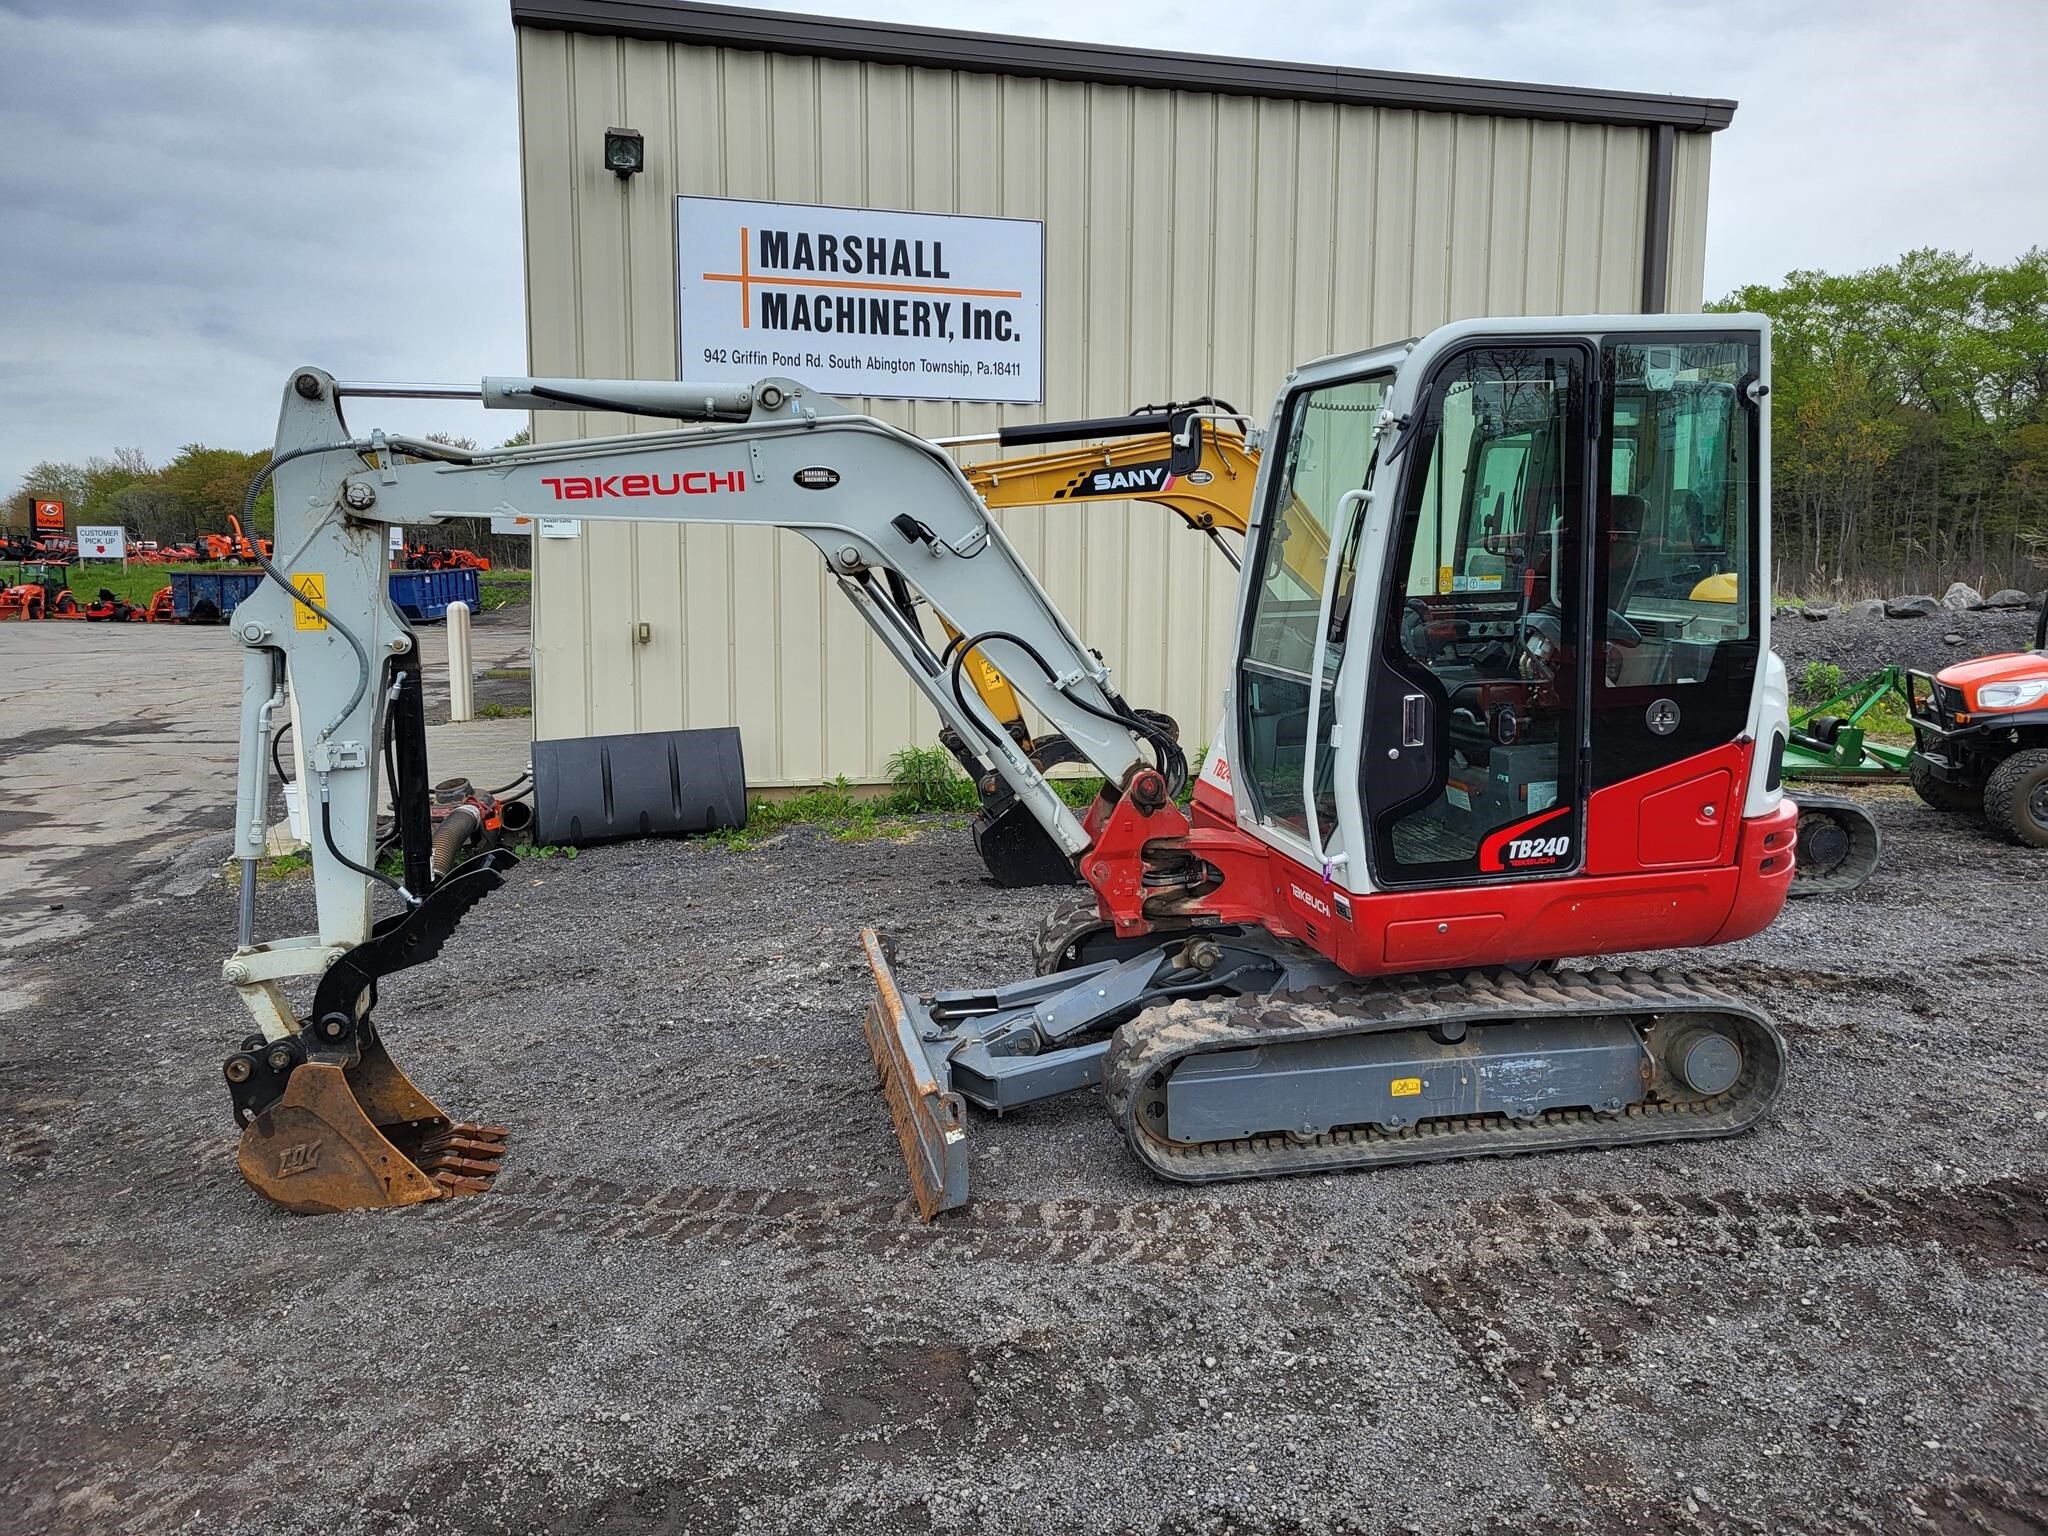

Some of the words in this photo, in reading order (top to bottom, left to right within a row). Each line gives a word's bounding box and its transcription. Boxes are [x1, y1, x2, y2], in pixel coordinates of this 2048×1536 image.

[759, 229, 950, 279] MARSHALL
[760, 291, 955, 343] MACHINERY,
[962, 301, 1021, 342] Inc.
[703, 348, 727, 363] 942
[731, 349, 768, 365] Griffin
[772, 351, 801, 367] Pond
[805, 353, 824, 368] Rd.
[828, 354, 862, 370] South
[866, 356, 916, 374] Abington
[919, 358, 973, 376] Township,
[976, 361, 1021, 376] Pa.18411
[541, 470, 745, 500] TAKEUCHI
[1093, 467, 1163, 491] SANY
[80, 529, 119, 537] CUSTOMER
[85, 537, 102, 545] PICK
[1509, 836, 1570, 859] TB240
[1290, 883, 1331, 918] TAKEUCHI
